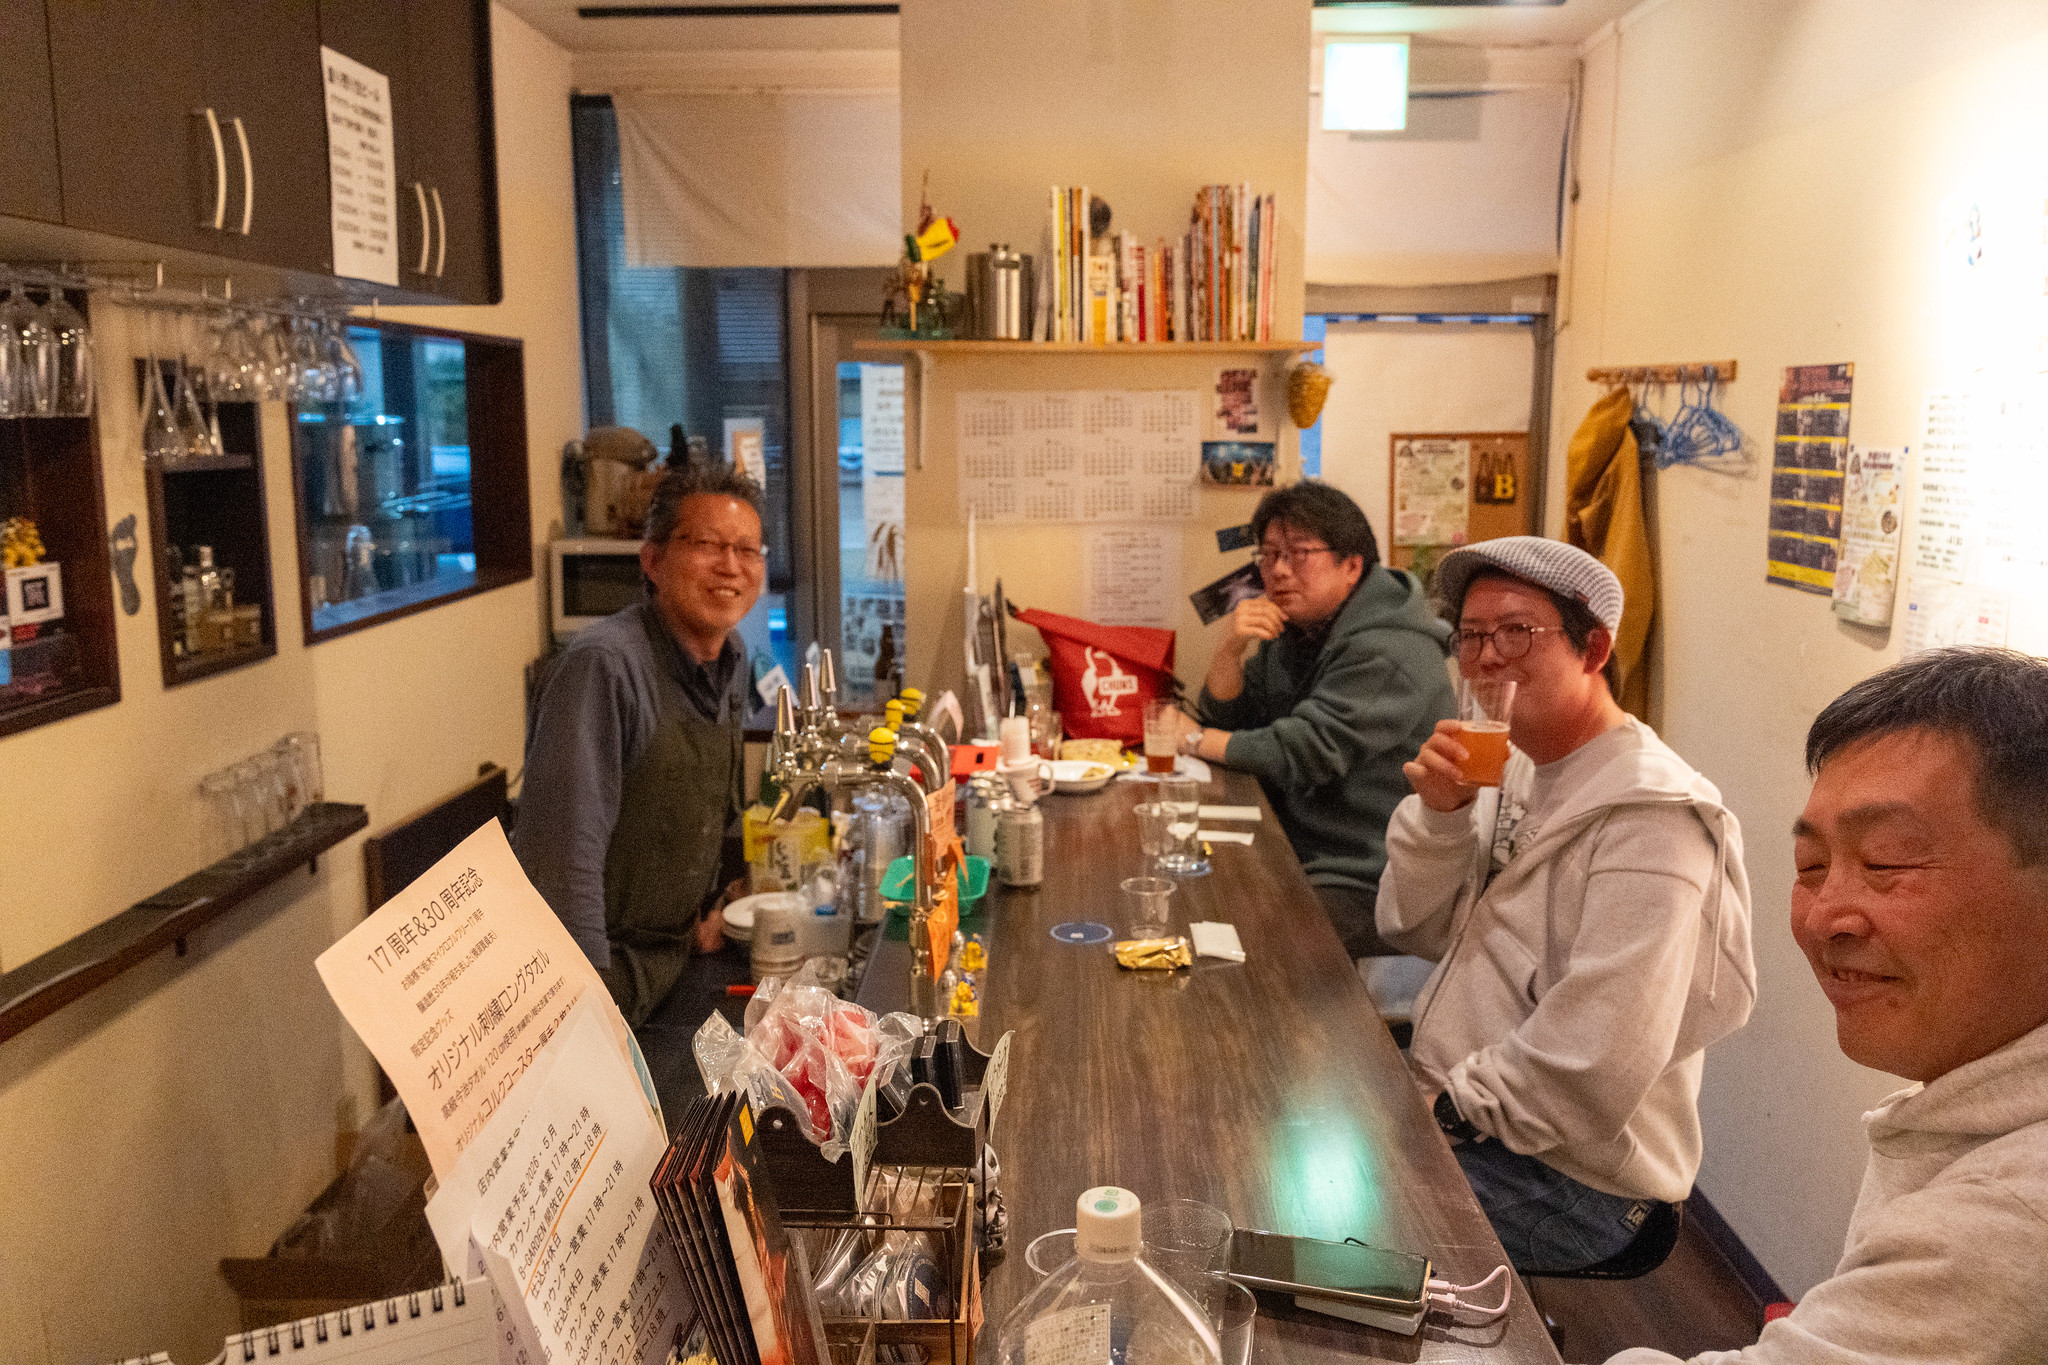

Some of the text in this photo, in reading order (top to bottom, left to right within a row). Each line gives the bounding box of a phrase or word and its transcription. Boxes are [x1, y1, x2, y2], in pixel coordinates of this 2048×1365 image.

[428, 948, 550, 1091] オリジナル刺繍ロングタオル
[530, 1233, 562, 1299] 仕込み休日
[553, 1268, 584, 1336] 仕込み休日
